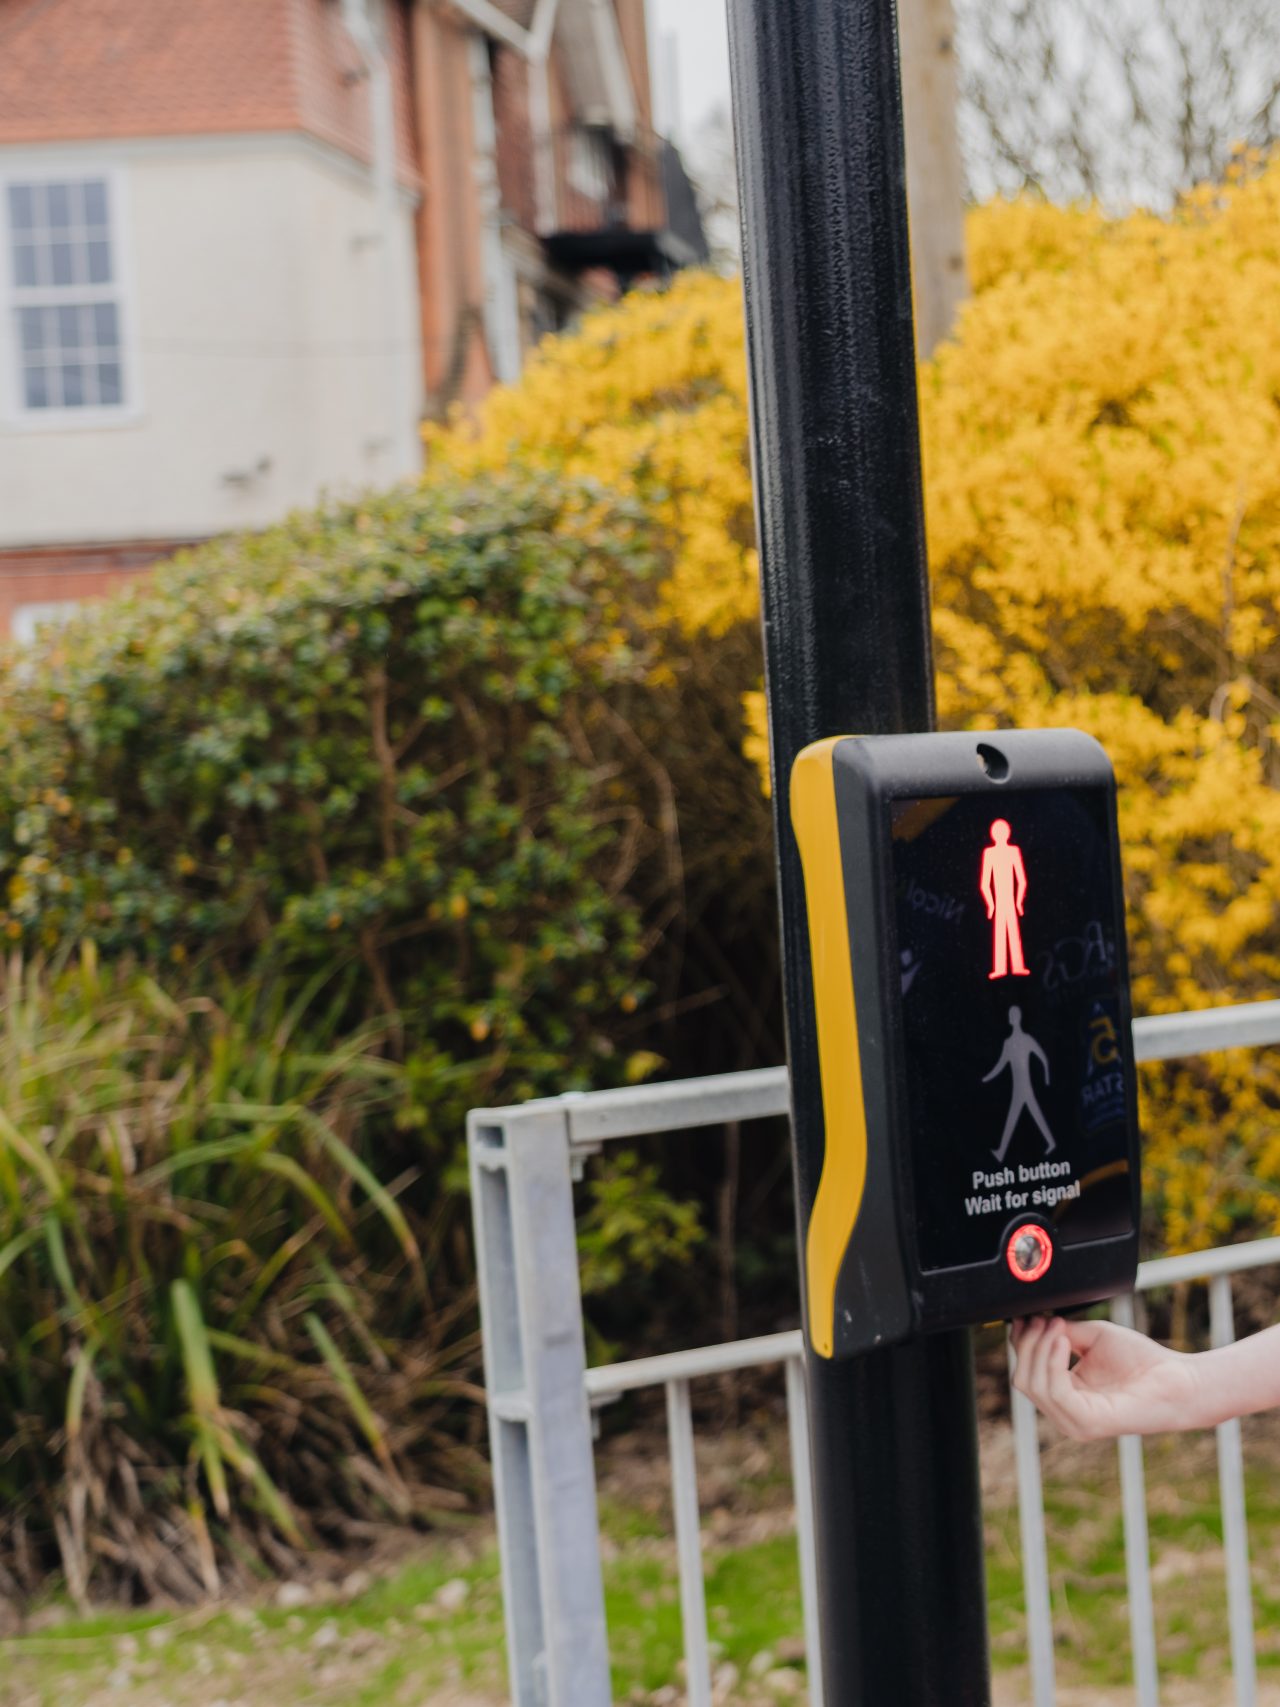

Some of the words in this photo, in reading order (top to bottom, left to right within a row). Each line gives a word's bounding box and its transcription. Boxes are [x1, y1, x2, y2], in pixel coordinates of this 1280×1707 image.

[972, 1166, 1015, 1190] Push
[1018, 1161, 1071, 1183] button
[965, 1194, 1002, 1216] Wait
[1004, 1190, 1029, 1209] for
[1032, 1179, 1081, 1207] signal
